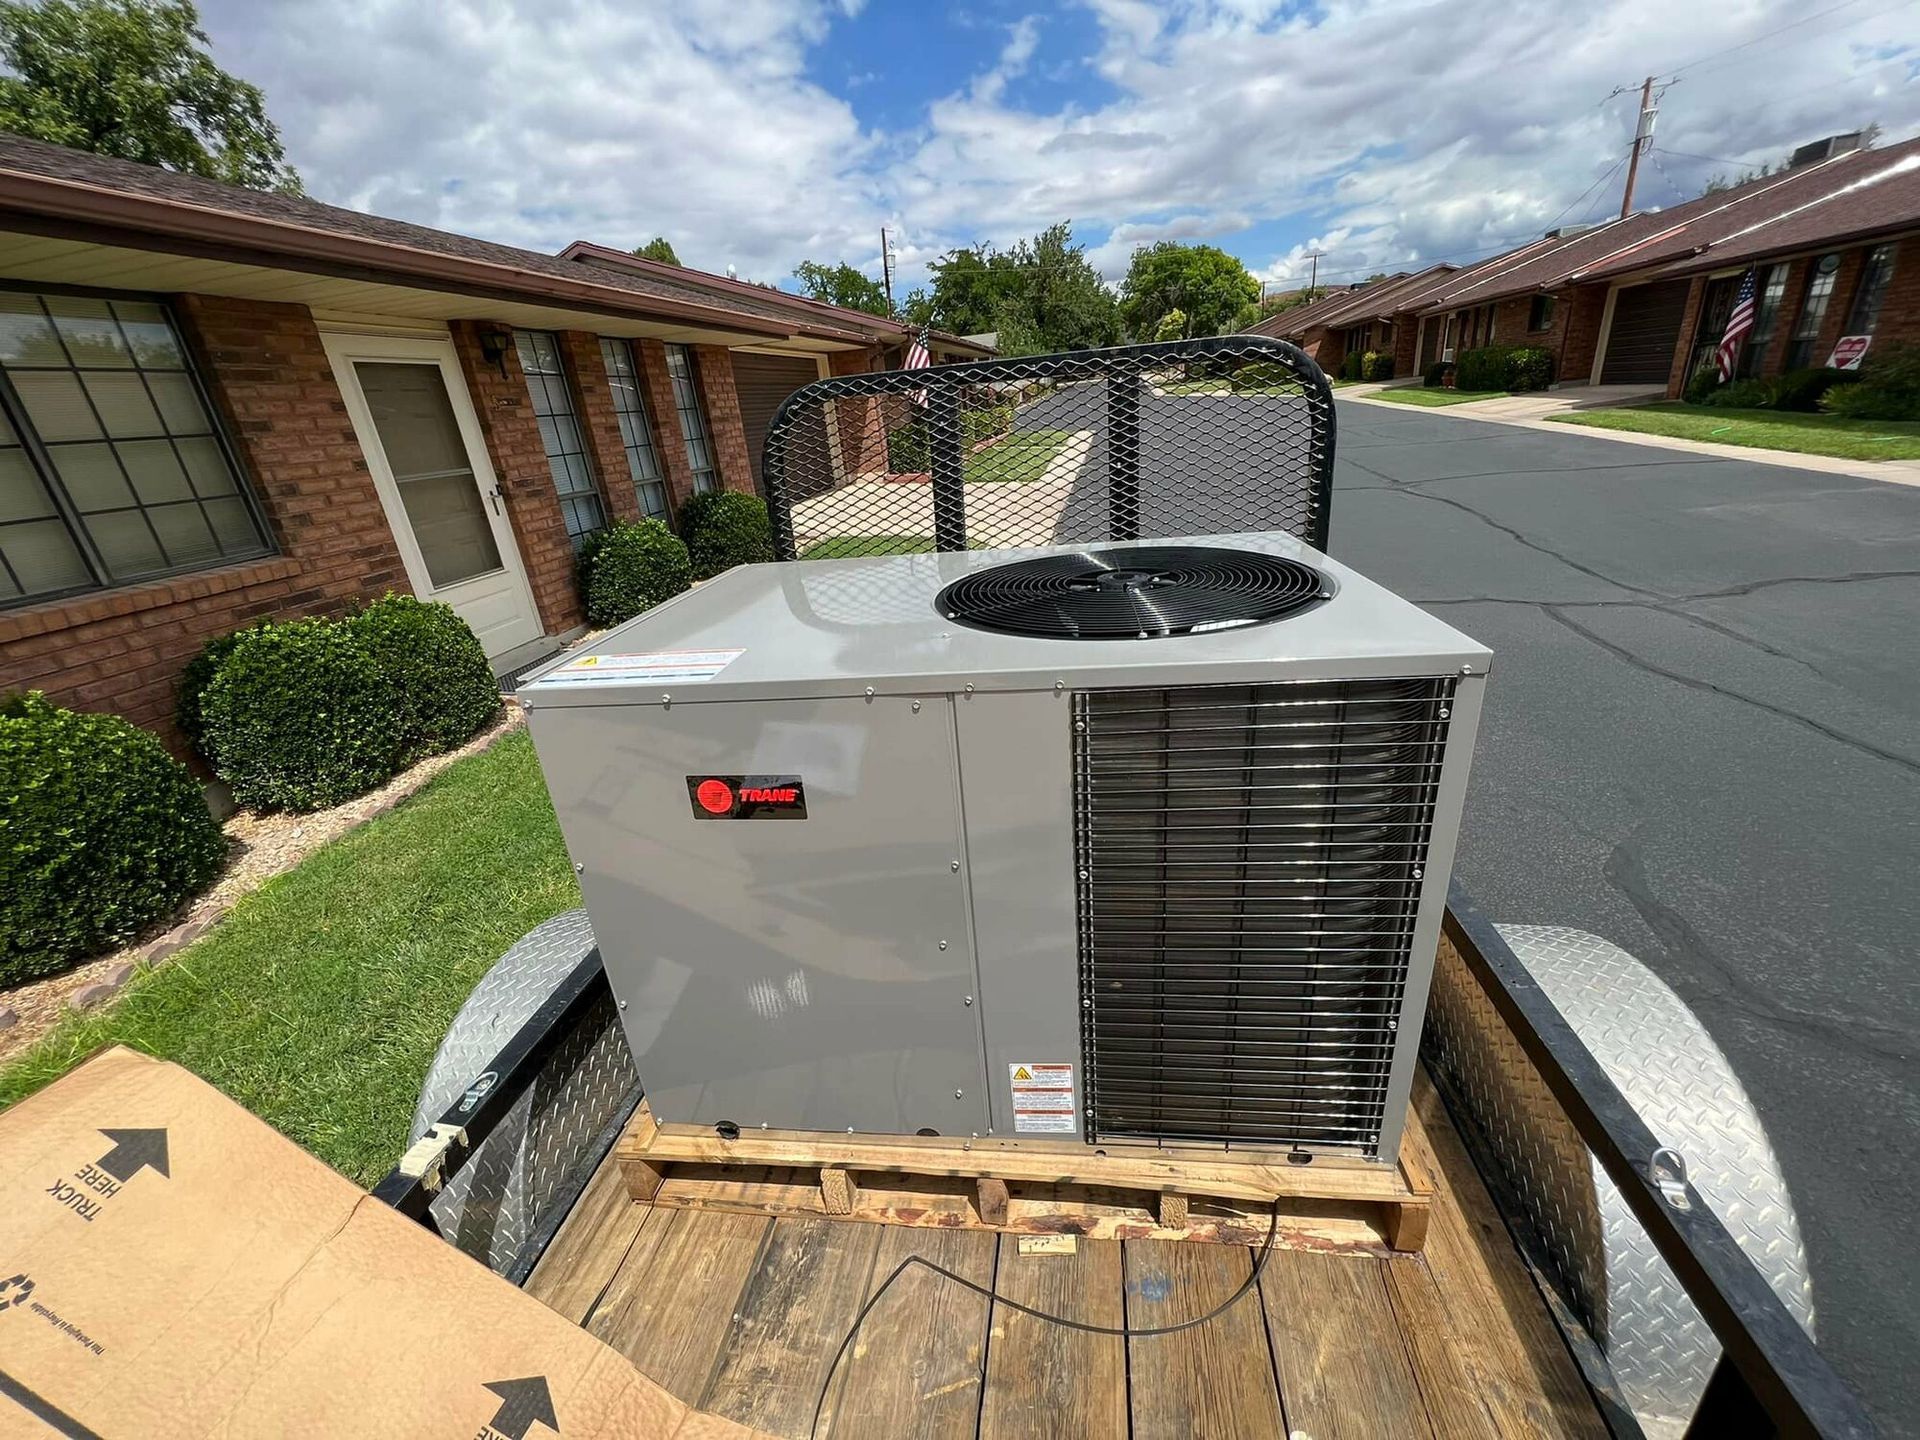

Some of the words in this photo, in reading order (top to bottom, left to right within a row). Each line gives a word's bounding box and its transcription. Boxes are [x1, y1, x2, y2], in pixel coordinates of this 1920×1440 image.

[739, 788, 800, 802] TRANE
[74, 1163, 122, 1199] HERE
[45, 1178, 103, 1222] TRUCK
